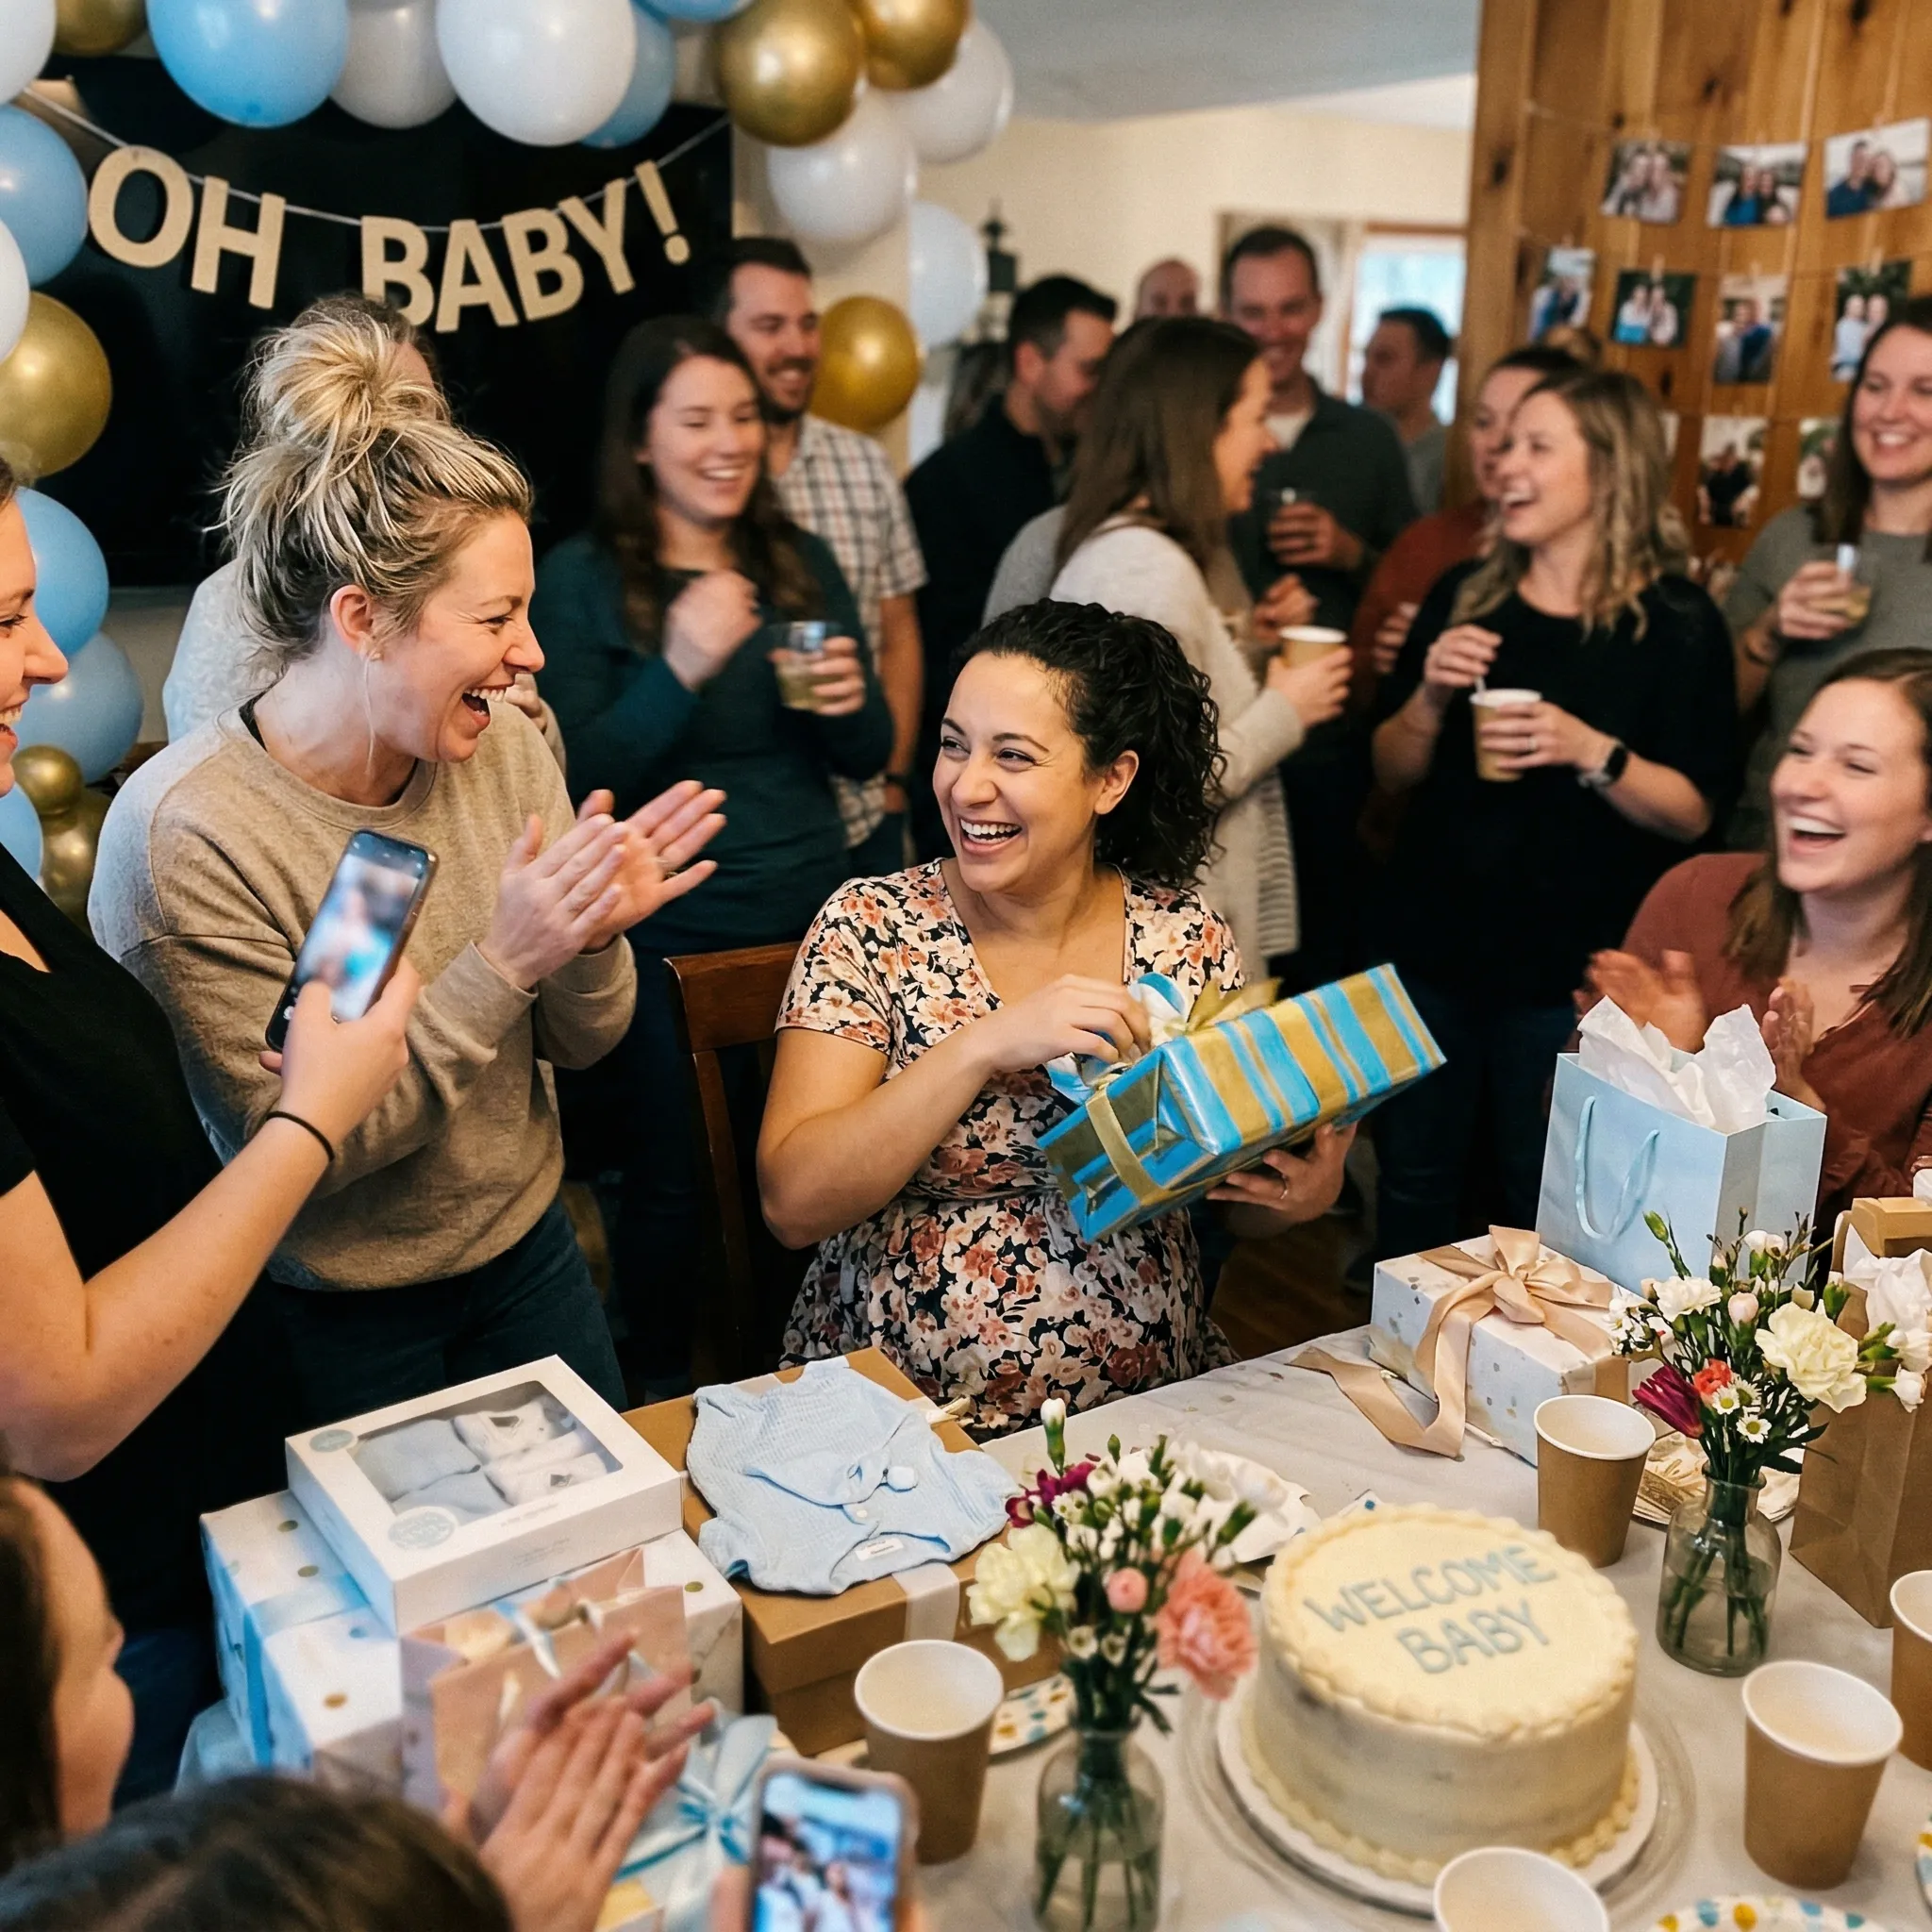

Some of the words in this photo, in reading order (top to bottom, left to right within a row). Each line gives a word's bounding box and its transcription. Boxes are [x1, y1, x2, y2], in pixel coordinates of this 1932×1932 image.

[88, 145, 286, 309] OH
[360, 159, 691, 333] BABY!
[1303, 1544, 1559, 1632] WELCOME
[1396, 1598, 1551, 1675] BABY
